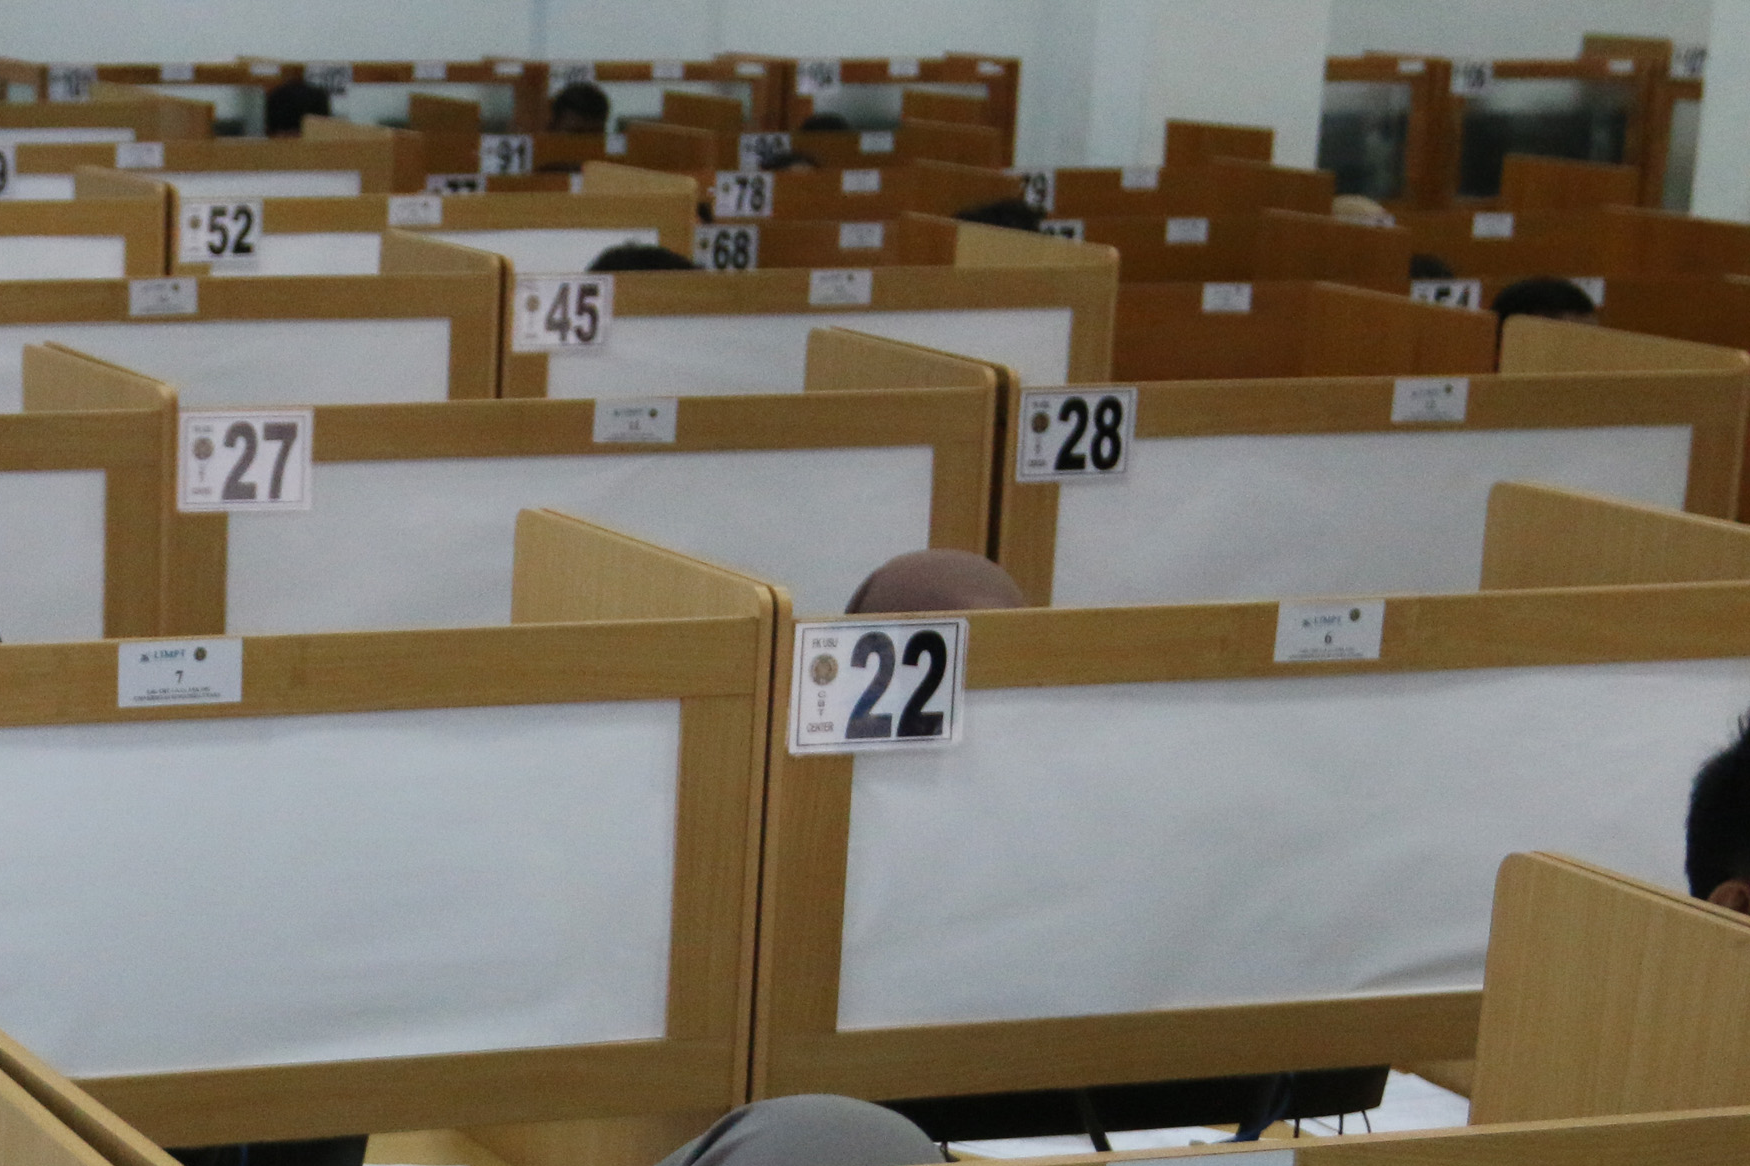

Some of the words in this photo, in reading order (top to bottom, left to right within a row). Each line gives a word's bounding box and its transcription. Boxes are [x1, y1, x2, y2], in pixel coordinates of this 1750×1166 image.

[206, 204, 254, 255] 52
[712, 229, 750, 269] 68
[544, 282, 601, 344] 45
[221, 420, 298, 500] 27
[1054, 394, 1124, 471] 28
[175, 670, 184, 683] 7
[845, 629, 948, 739] 22
[806, 722, 834, 733] CENTER
